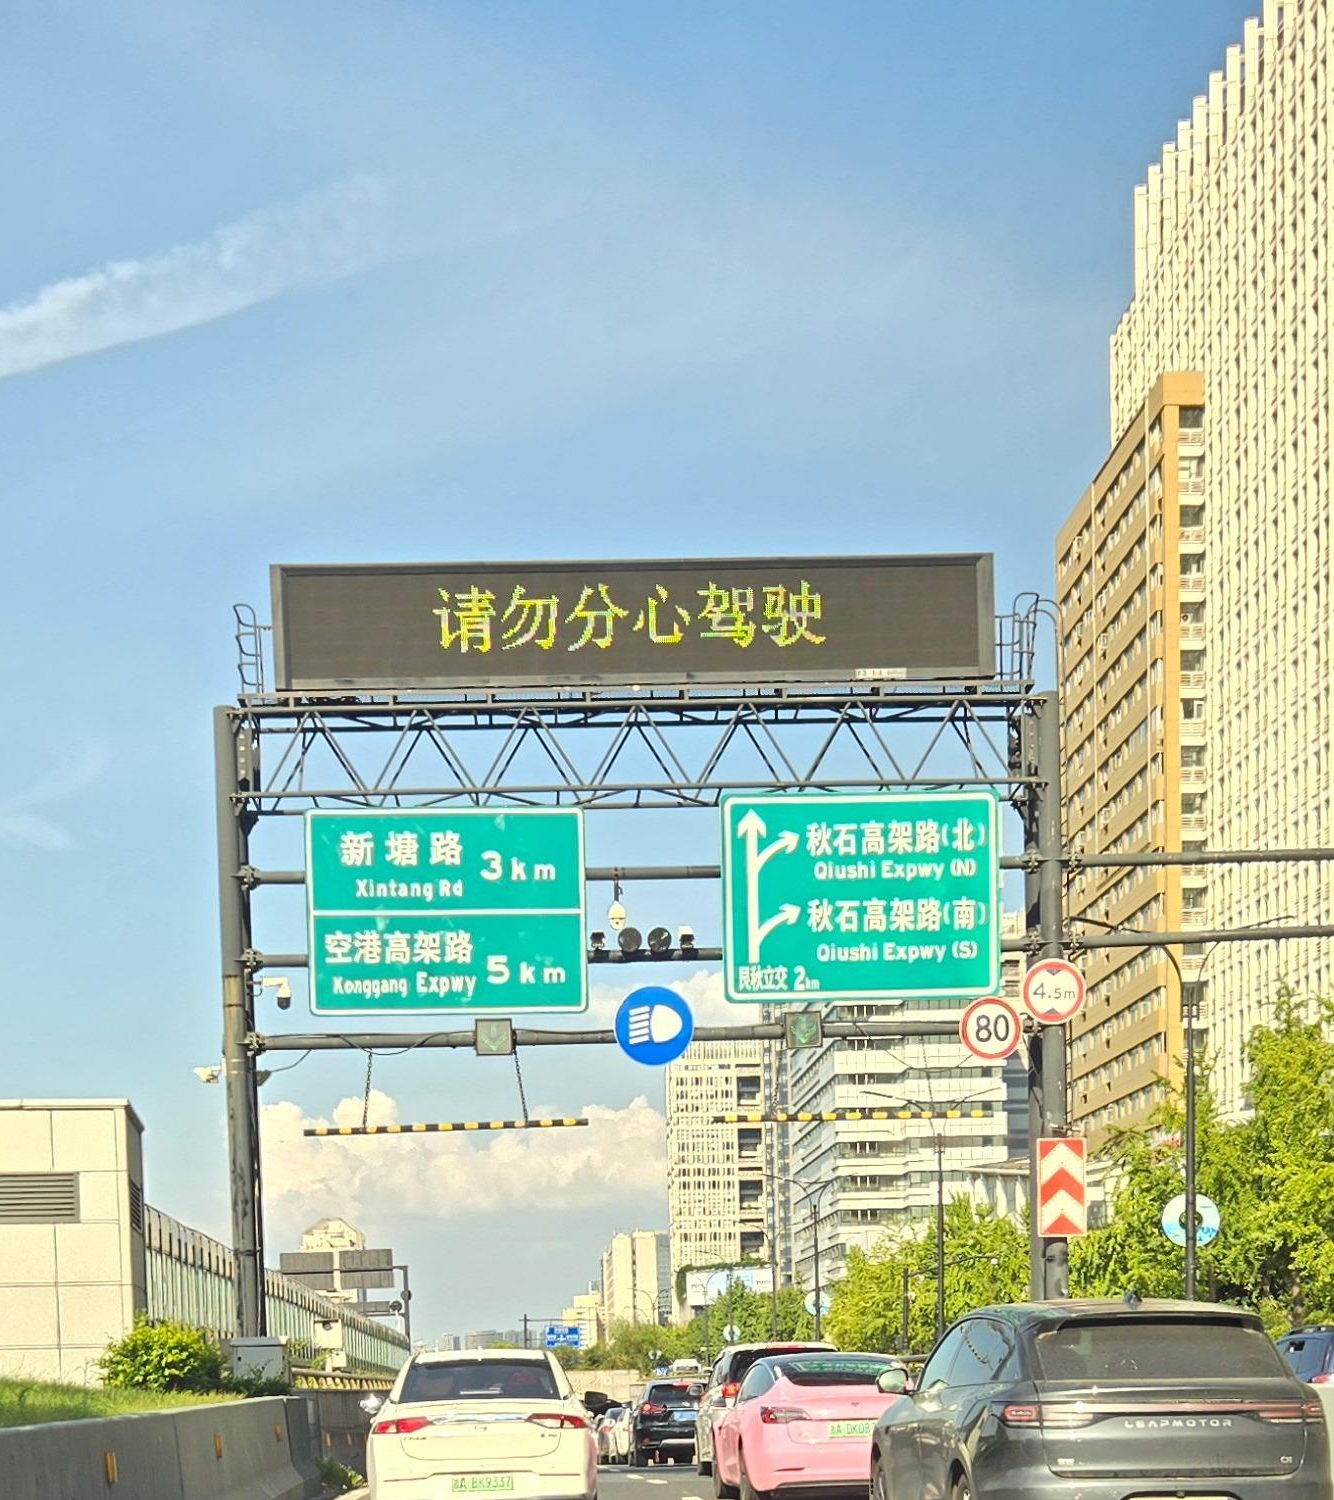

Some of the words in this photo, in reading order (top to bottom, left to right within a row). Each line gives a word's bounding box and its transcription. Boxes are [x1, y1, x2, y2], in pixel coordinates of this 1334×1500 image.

[433, 580, 827, 653] 请勿分心驾驶
[340, 830, 463, 867] 新塘路
[806, 818, 987, 857] 秋石高架路(北)
[814, 860, 876, 880] Qiushi
[881, 859, 945, 881] Expwy
[950, 858, 977, 877] (N)
[356, 879, 434, 902] Xintang
[439, 879, 463, 897] Rd
[807, 897, 987, 933] 秋石高架路(南)
[324, 930, 474, 965] 空港高架路
[816, 943, 879, 962] Qiushi
[883, 942, 947, 963] Expwy
[952, 941, 978, 960] (S)
[333, 976, 408, 999] Konggang
[416, 971, 477, 997] Expwy
[1033, 982, 1076, 999] 4.5m
[975, 1014, 1009, 1042] 80
[1123, 1419, 1233, 1428] LEAPMOTOR
